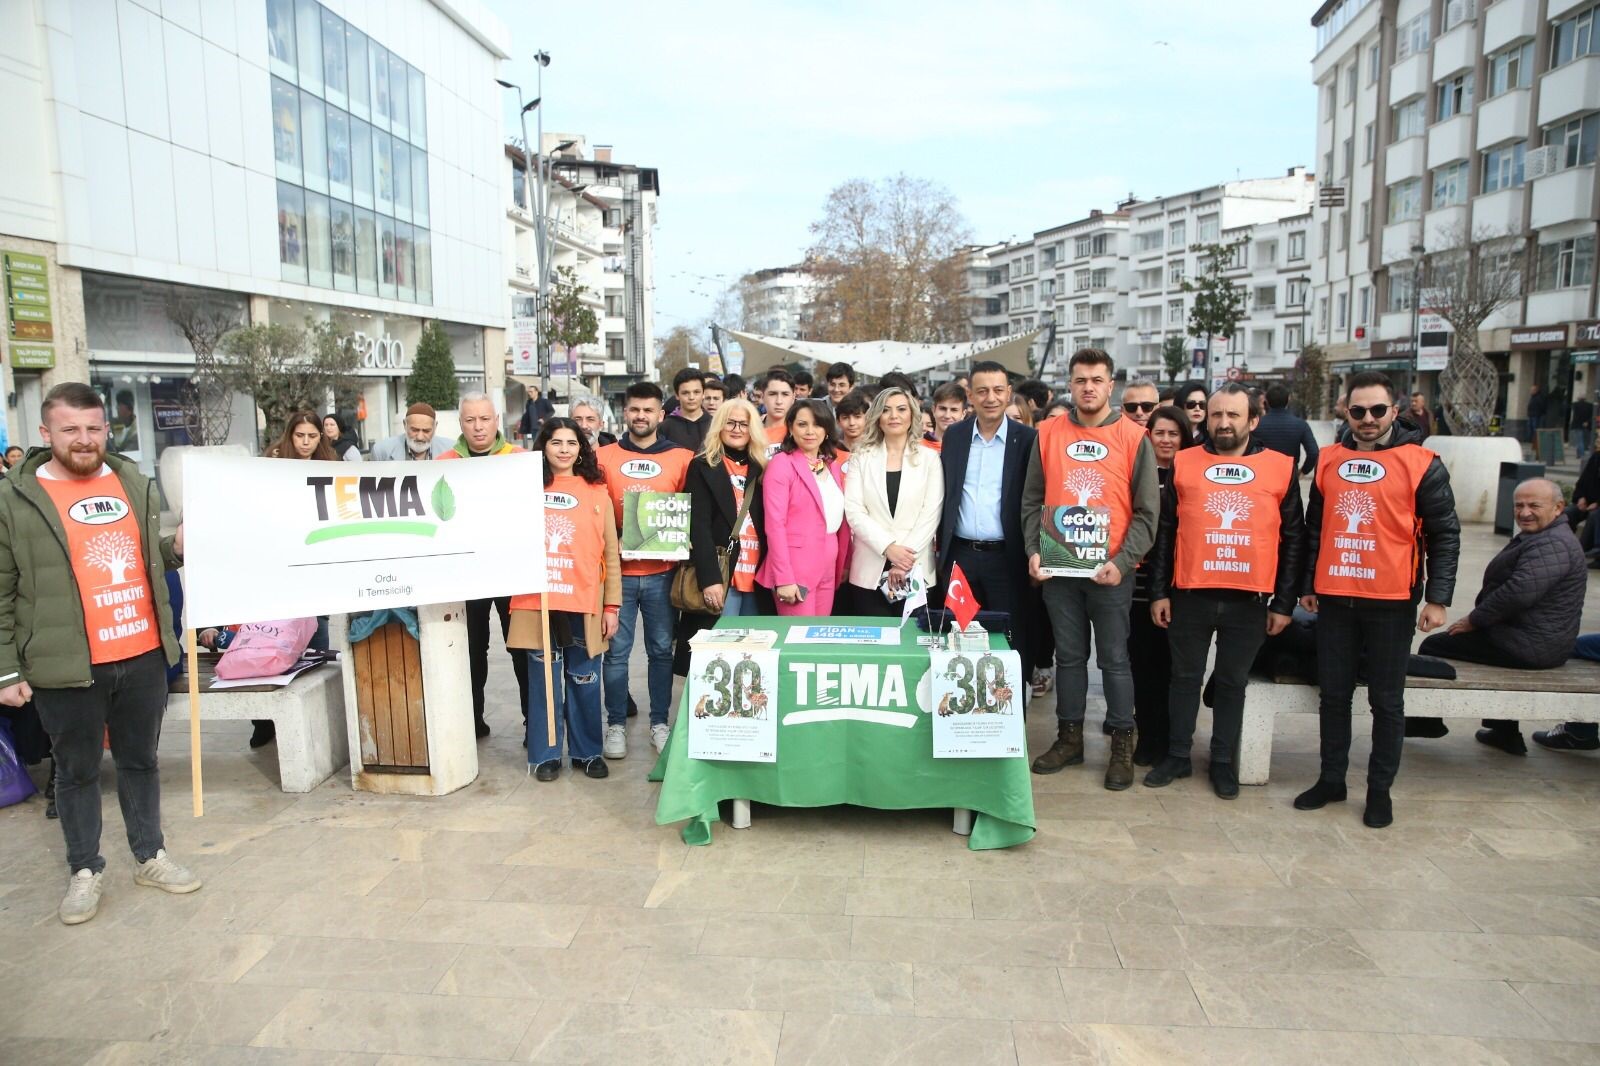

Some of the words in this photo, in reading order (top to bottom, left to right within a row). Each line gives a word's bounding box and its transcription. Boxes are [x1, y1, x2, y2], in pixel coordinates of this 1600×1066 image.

[1076, 445, 1095, 453] TEMA
[630, 463, 649, 471] TEMA
[1215, 467, 1240, 477] TEMA
[1347, 463, 1371, 474] TEMA
[307, 475, 426, 521] TEMA
[80, 500, 114, 515] TEMA
[647, 513, 687, 528] LÜNÜ
[657, 530, 687, 543] VER
[1065, 528, 1106, 544] LÜNÜ
[1205, 531, 1250, 546] TÜRKİYE
[1334, 535, 1376, 551] TÜRKİYE
[1075, 547, 1106, 560] VER
[1216, 546, 1237, 559] ÇÖL
[1340, 551, 1361, 565] ÇÖL
[1203, 560, 1250, 573] OLMASIN
[1328, 565, 1376, 580] OLMASIN
[374, 574, 397, 584] Ordu
[366, 585, 413, 597] Temsilciliği
[548, 582, 574, 594] MASIN
[93, 585, 144, 608] TÜRKİYE
[113, 604, 138, 623] ÇÖL
[98, 618, 149, 642] OLMASIN
[705, 658, 762, 718] 30
[789, 662, 908, 707] TEMA
[947, 655, 1005, 714] 30
